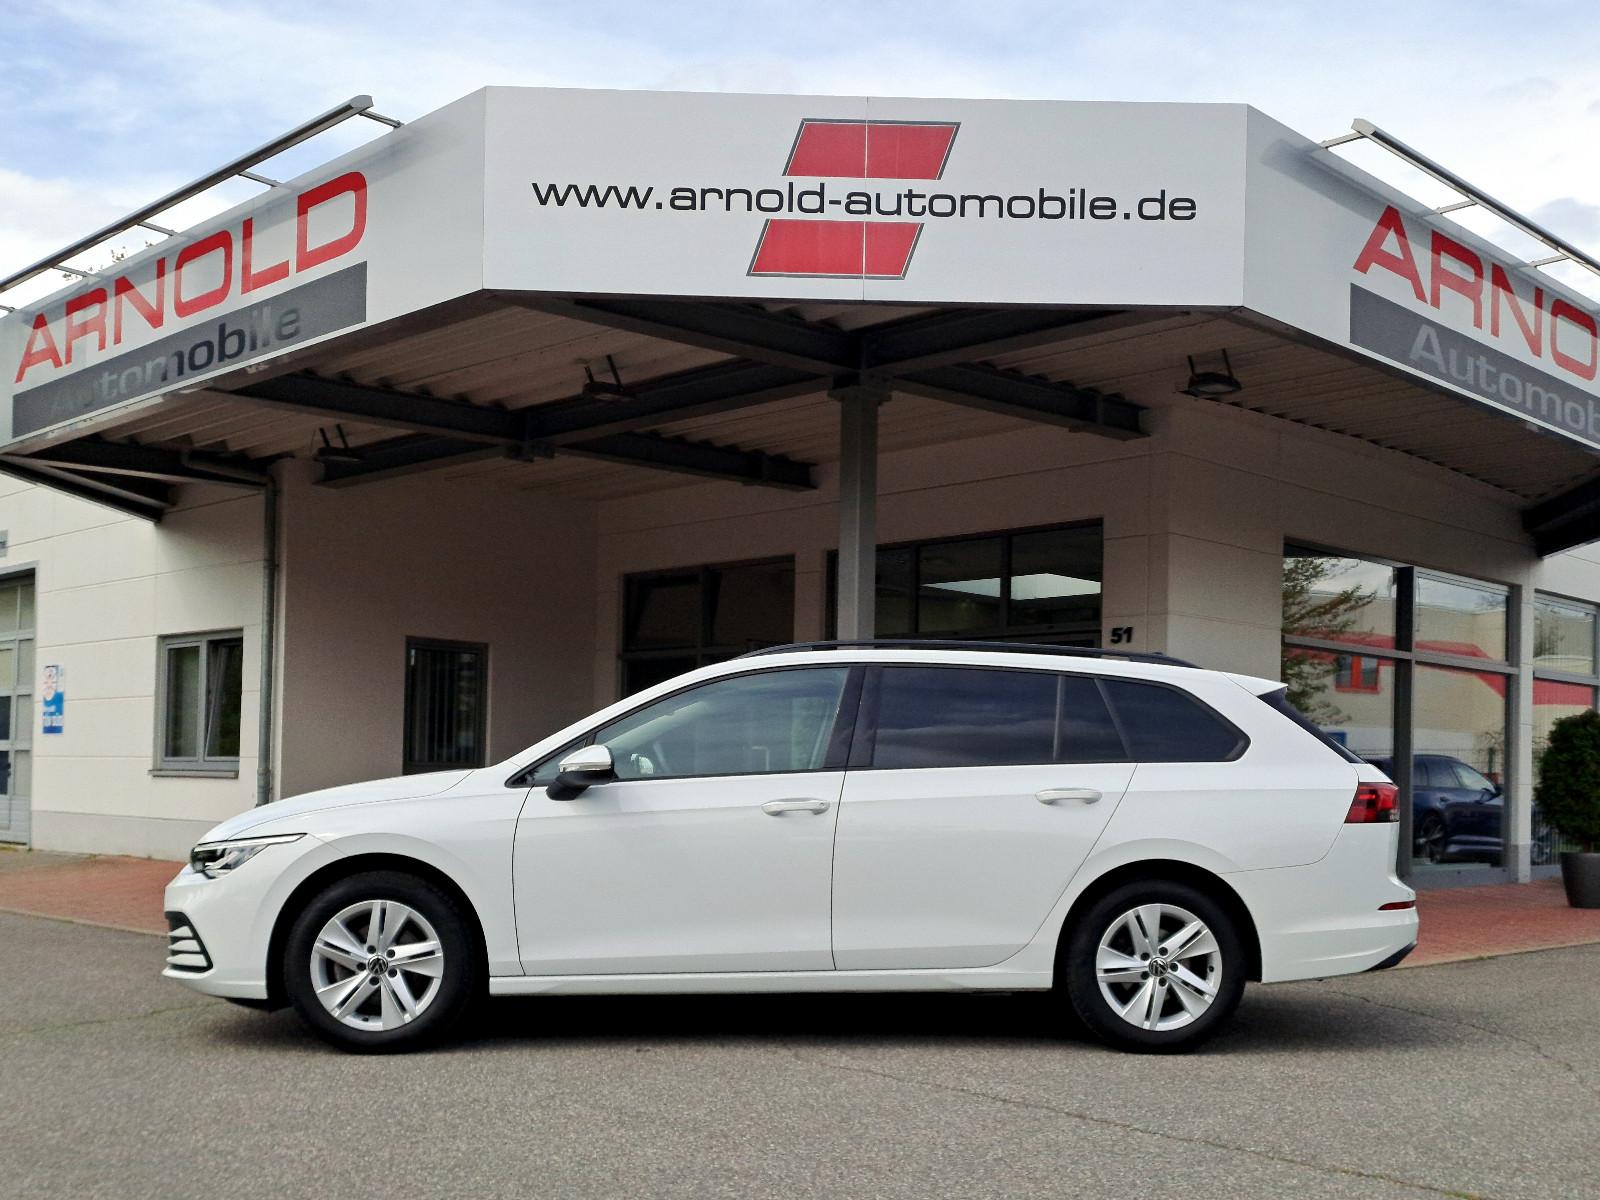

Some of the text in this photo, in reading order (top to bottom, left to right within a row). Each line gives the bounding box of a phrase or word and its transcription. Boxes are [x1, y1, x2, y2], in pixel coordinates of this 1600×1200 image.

[531, 182, 1197, 221] www.arnold-automobile.de
[14, 171, 368, 384] ARNOLD
[1353, 204, 1598, 382] ARNO
[1110, 626, 1133, 644] 51
